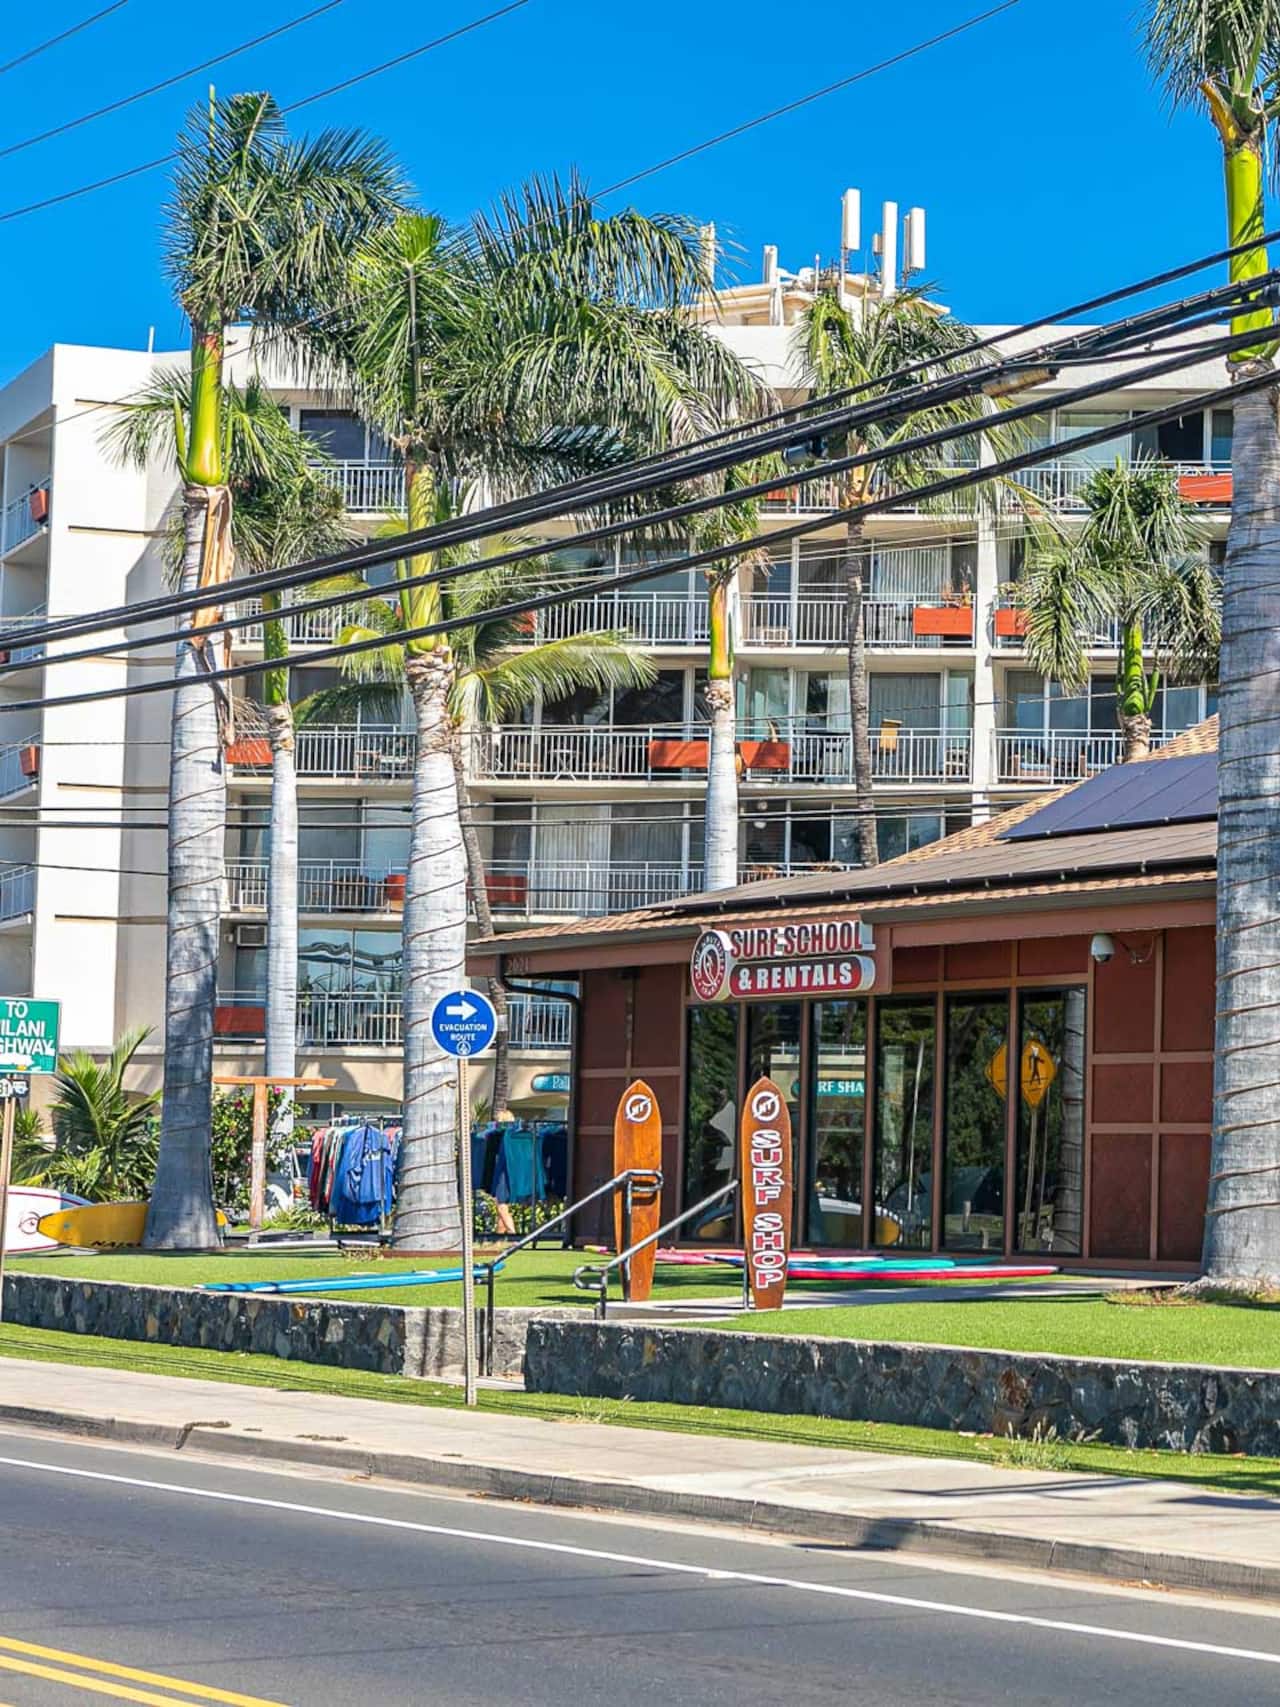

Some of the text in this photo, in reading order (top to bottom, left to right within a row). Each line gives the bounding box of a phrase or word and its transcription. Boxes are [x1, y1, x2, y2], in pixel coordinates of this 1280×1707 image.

[730, 920, 863, 959] SURF SCHOOL
[738, 967, 752, 991] &
[756, 961, 853, 990] RENTALS
[6, 1001, 28, 1018] TO
[1, 1019, 46, 1037] ILANI
[439, 1024, 488, 1032] EVACUATION
[450, 1033, 476, 1041] ROUTE
[817, 1081, 834, 1093] RF
[751, 1129, 784, 1206] SURF
[752, 1212, 786, 1289] SHOP
